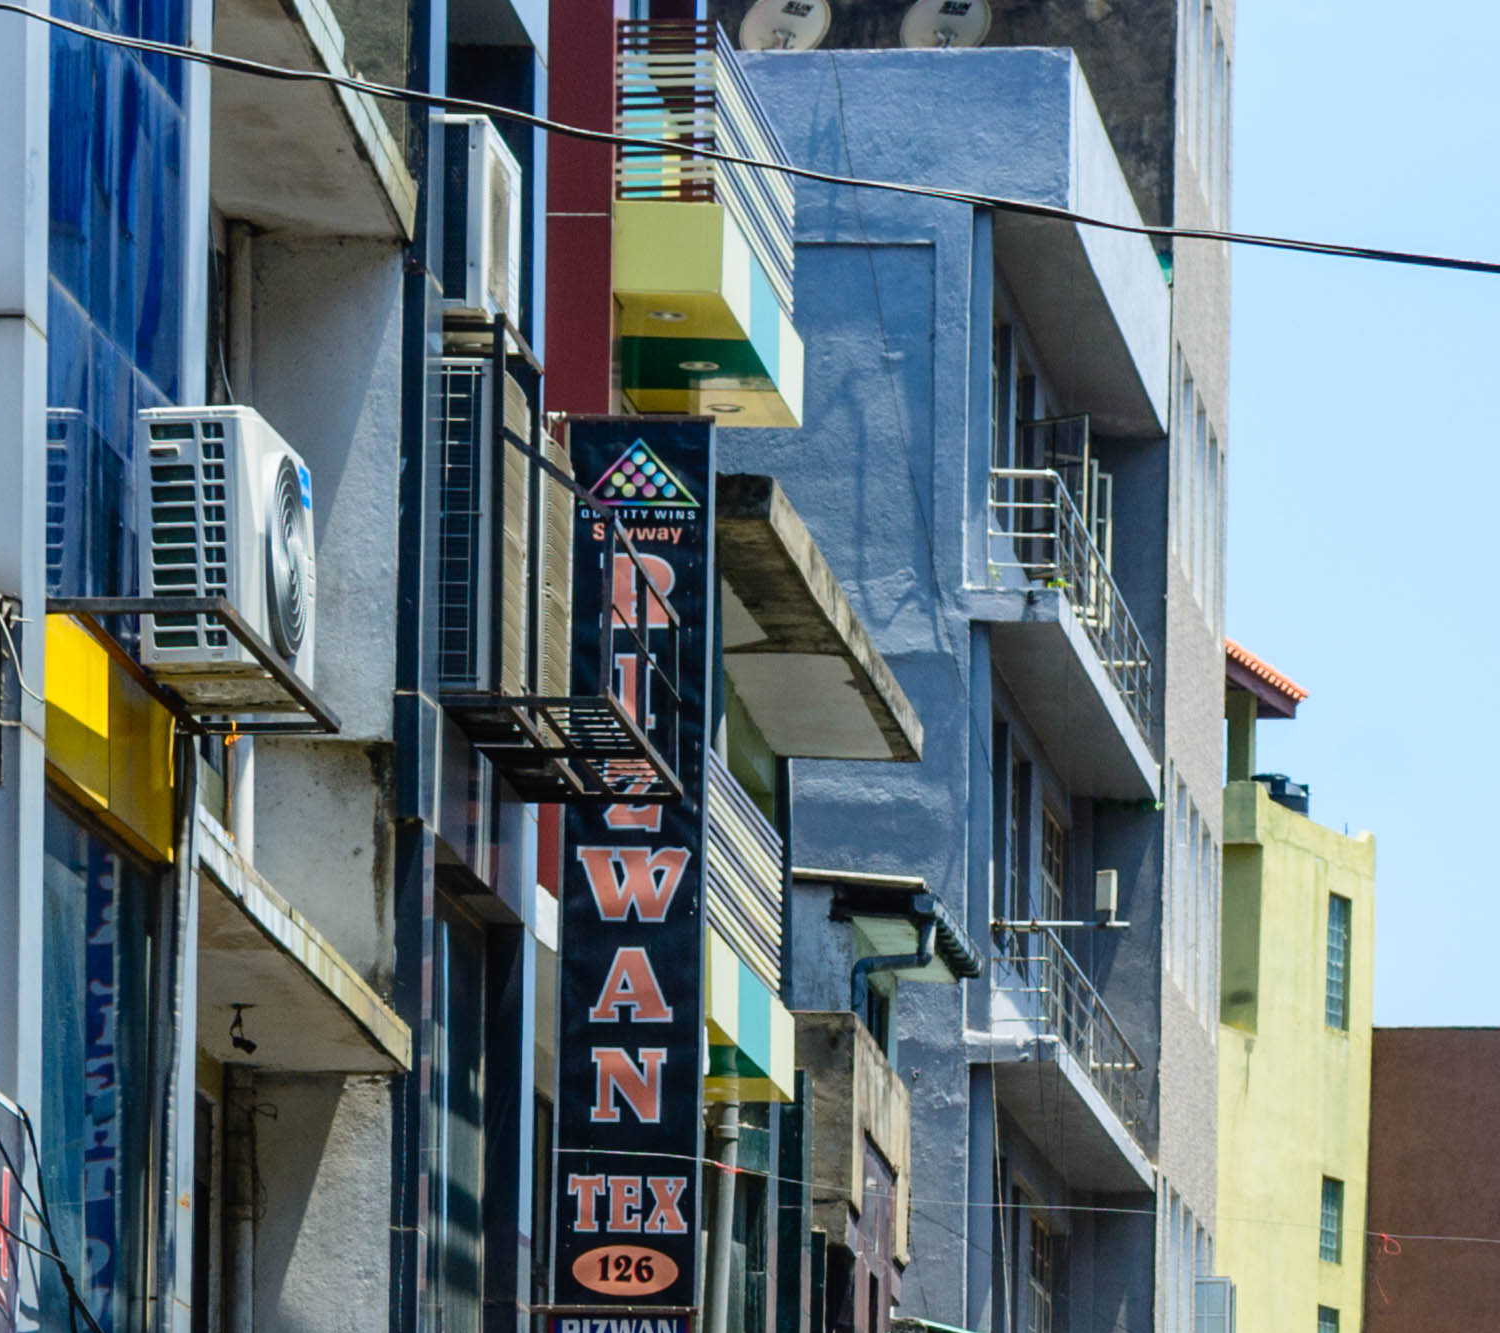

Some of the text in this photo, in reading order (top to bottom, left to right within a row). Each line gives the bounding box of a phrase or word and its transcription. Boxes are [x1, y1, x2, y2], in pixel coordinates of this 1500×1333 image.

[654, 508, 696, 520] WINS
[567, 1174, 689, 1234] TEX
[596, 1254, 655, 1283] 126
